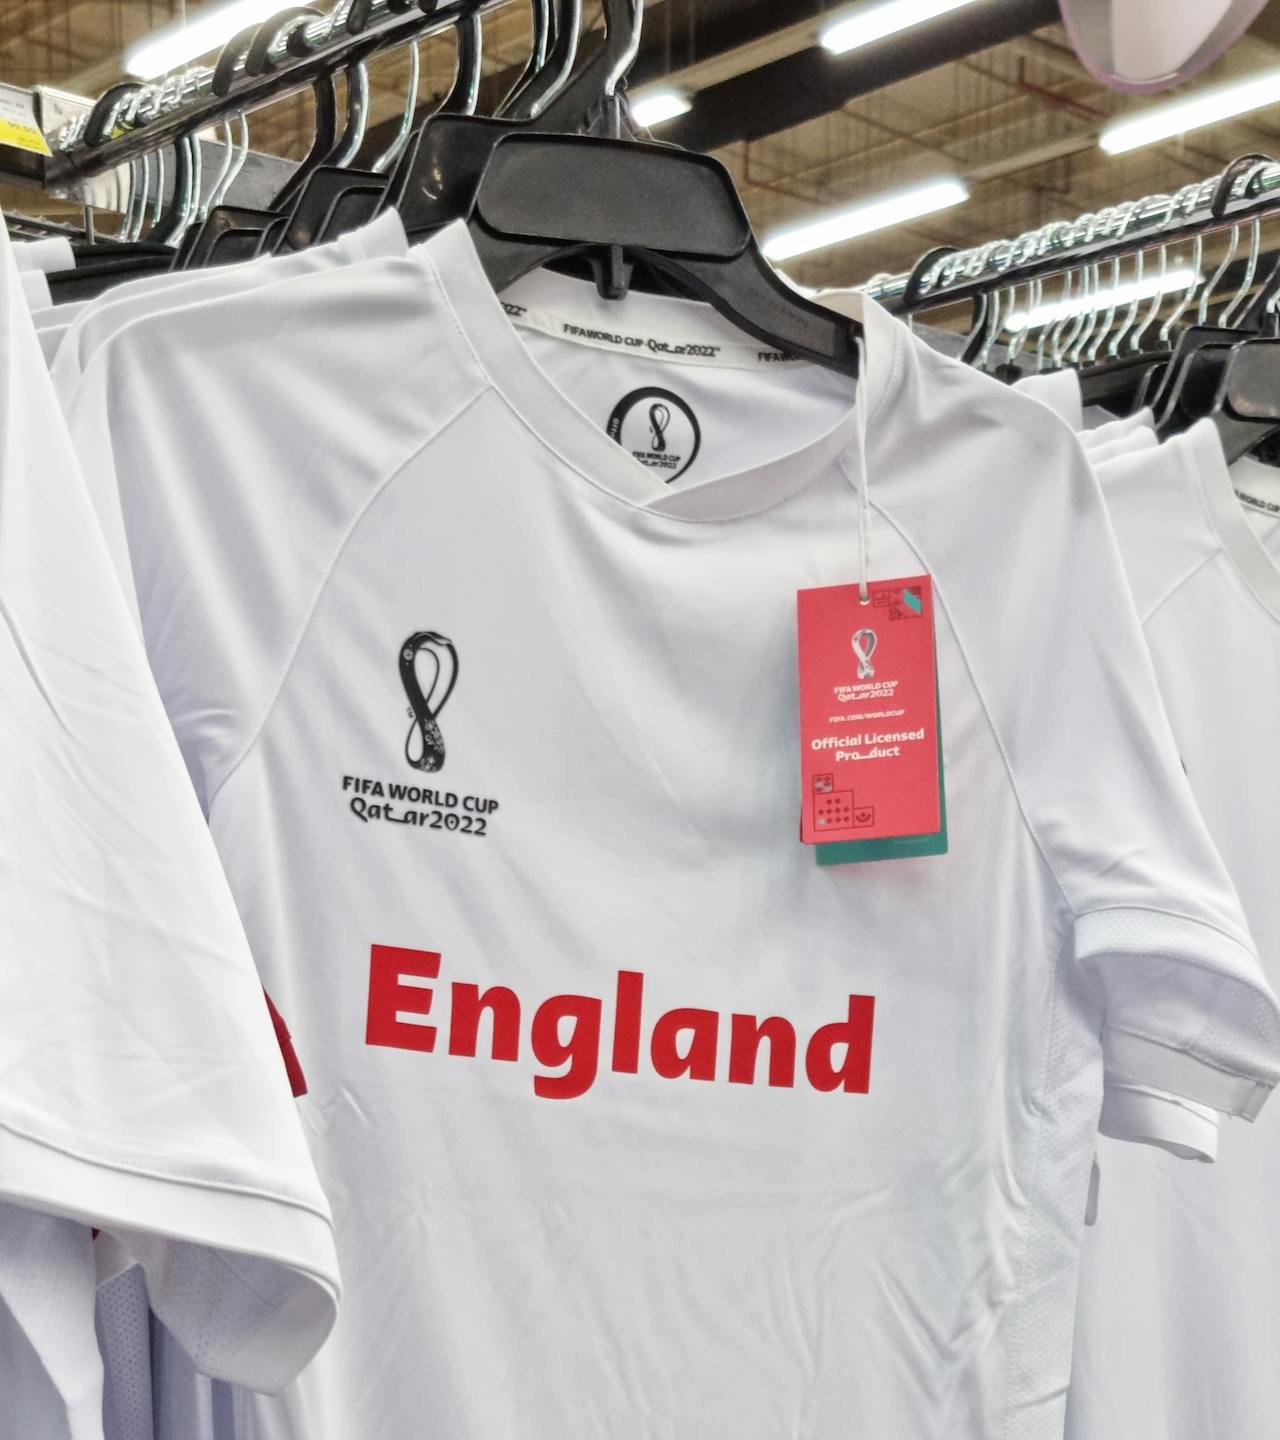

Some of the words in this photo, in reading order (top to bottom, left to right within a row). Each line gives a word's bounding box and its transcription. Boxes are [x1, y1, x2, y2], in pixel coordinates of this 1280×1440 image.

[563, 323, 586, 338] FIFA
[586, 330, 623, 345] WORLD
[624, 336, 644, 347] CUP
[834, 685, 852, 694] FIFA
[852, 682, 881, 692] WORLD
[882, 680, 898, 688] CUP
[811, 734, 861, 750] Official
[864, 728, 925, 745] Licensed
[342, 775, 385, 797] FIFA
[388, 783, 458, 808] WORLD
[463, 796, 499, 814] CUP
[366, 943, 875, 1100] England
